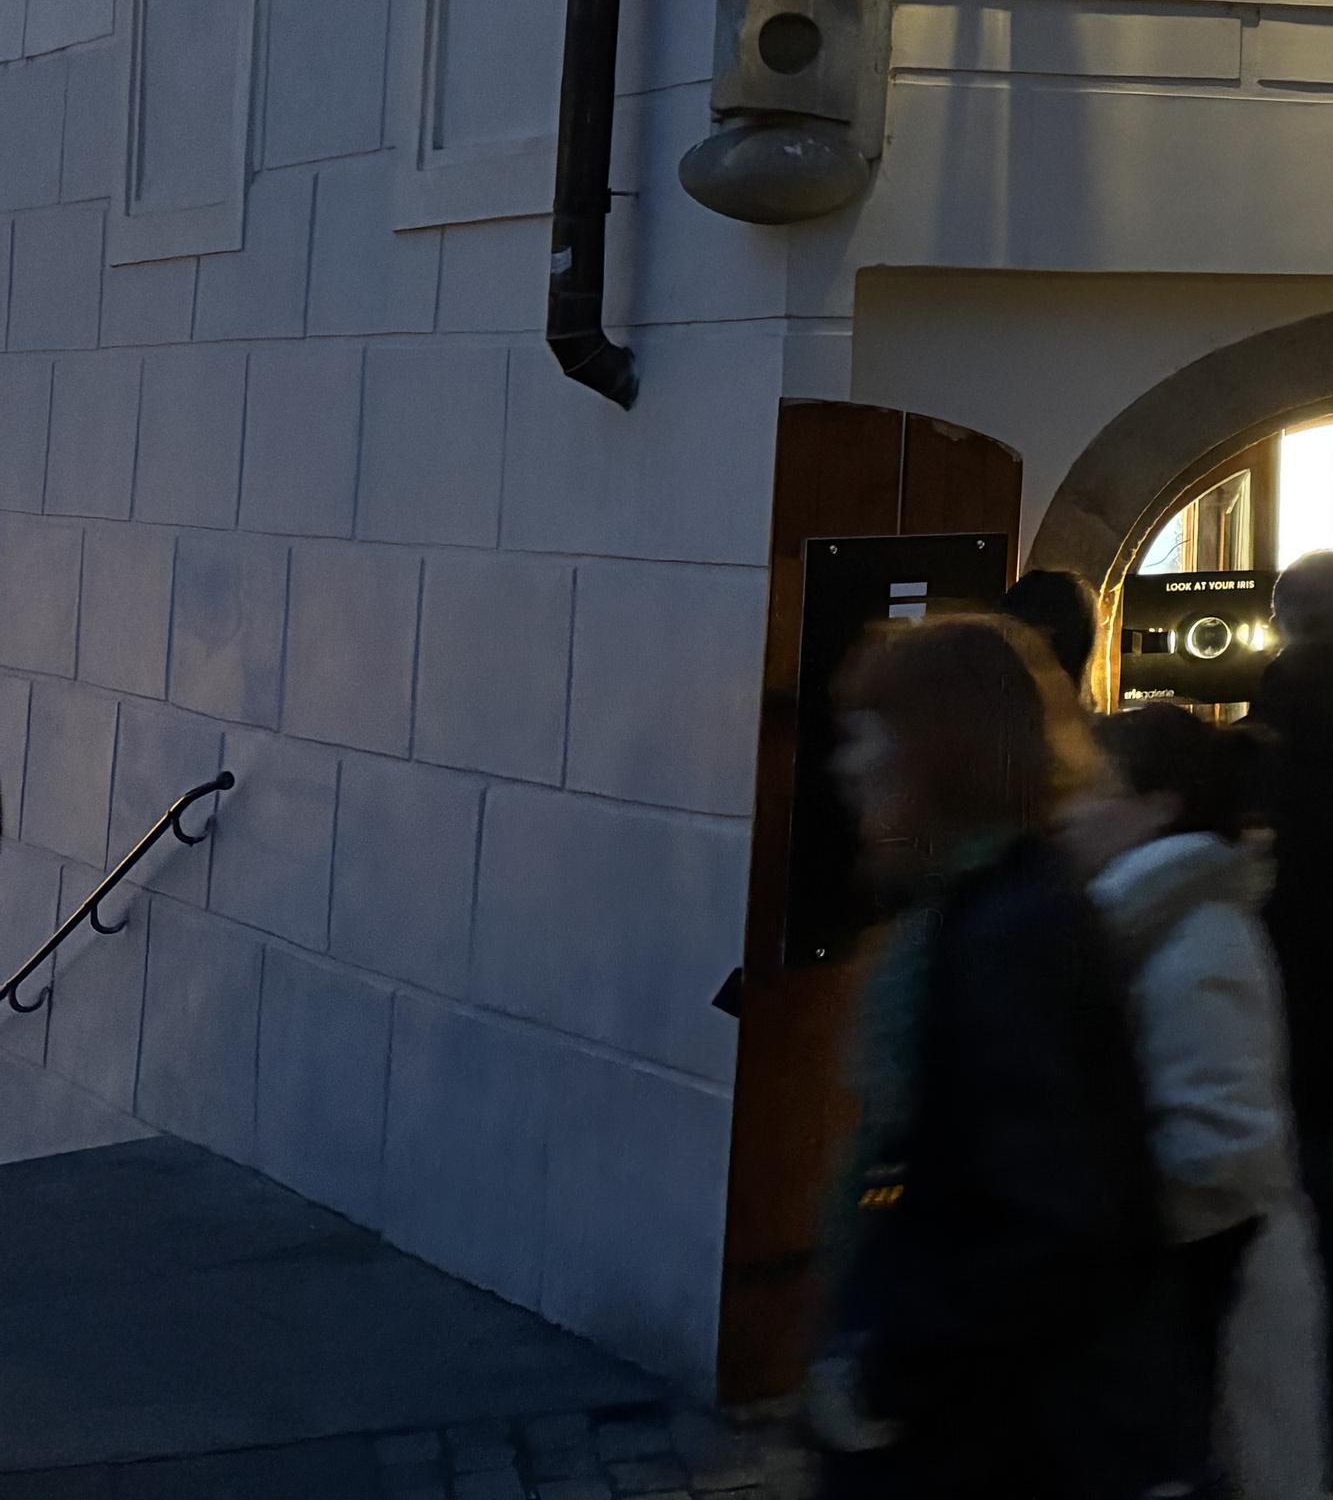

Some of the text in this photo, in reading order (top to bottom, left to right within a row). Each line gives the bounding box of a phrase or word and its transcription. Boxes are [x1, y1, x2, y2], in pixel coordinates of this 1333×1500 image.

[1166, 580, 1255, 592] LOOK AT YOUR IRIS
